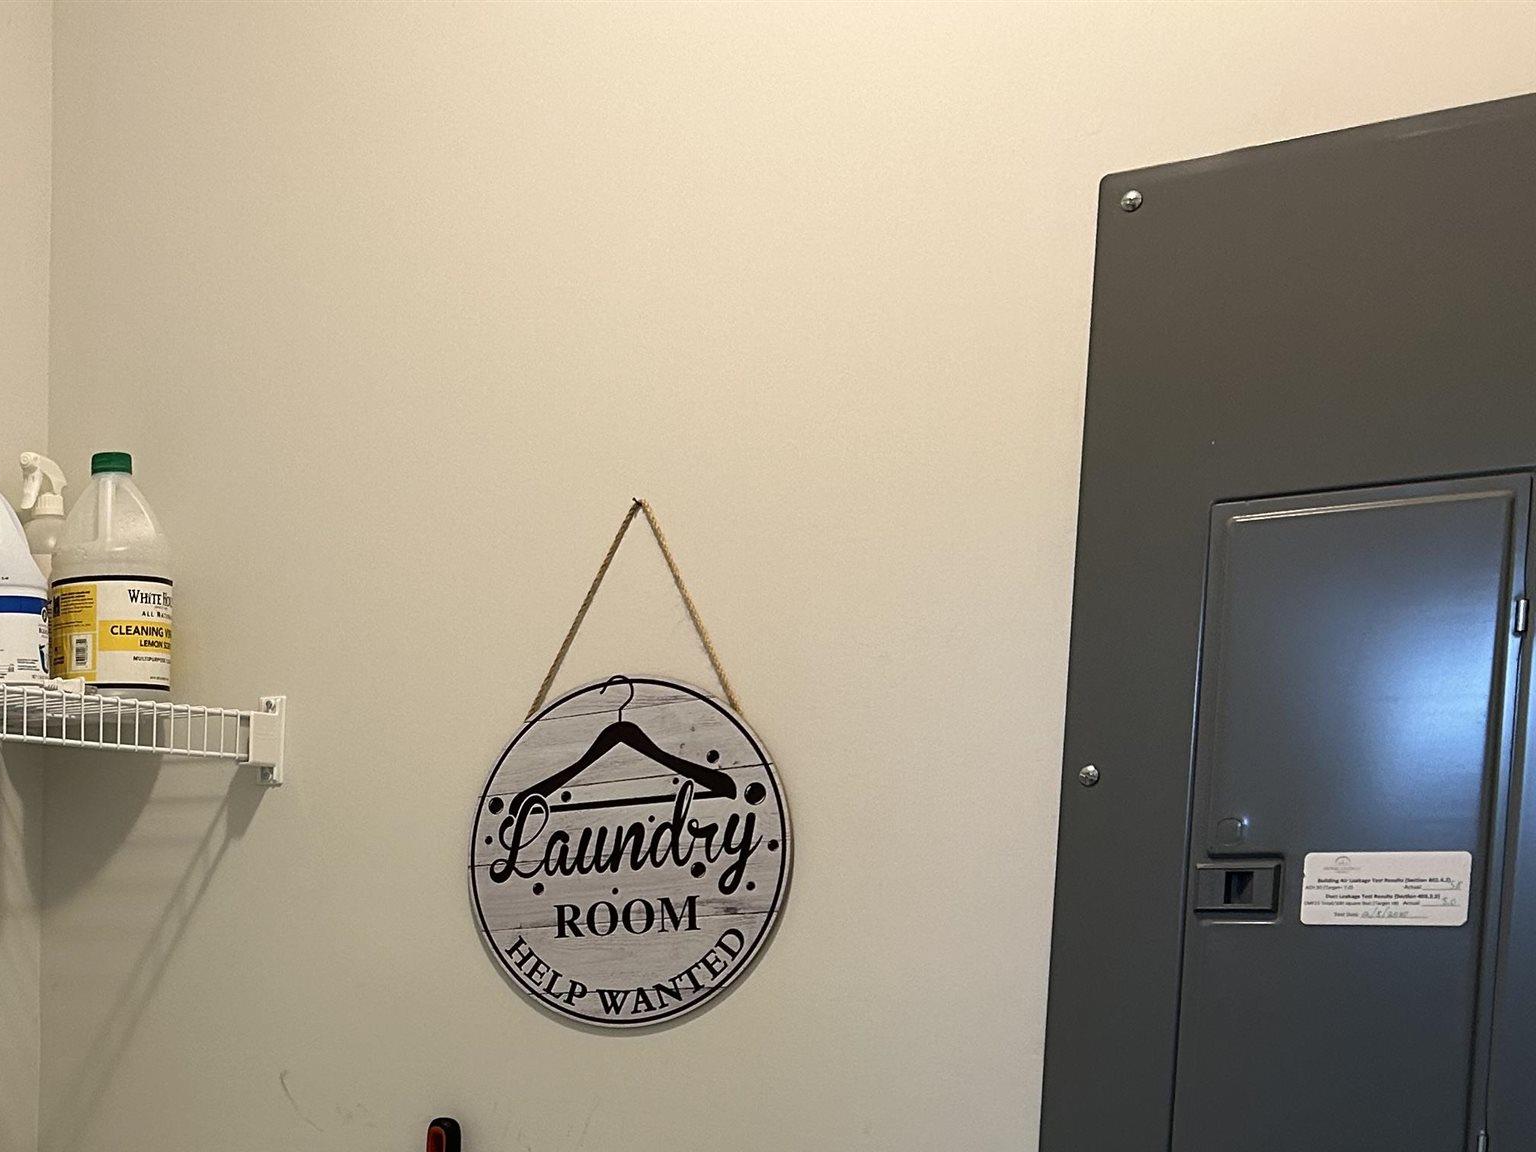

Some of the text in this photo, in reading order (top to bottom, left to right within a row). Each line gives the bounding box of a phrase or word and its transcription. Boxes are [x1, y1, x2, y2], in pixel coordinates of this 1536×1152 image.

[110, 624, 164, 638] CLEANING
[489, 779, 763, 895] Laundry
[553, 895, 701, 939] ROOM
[505, 928, 746, 1015] HELP WANTED
